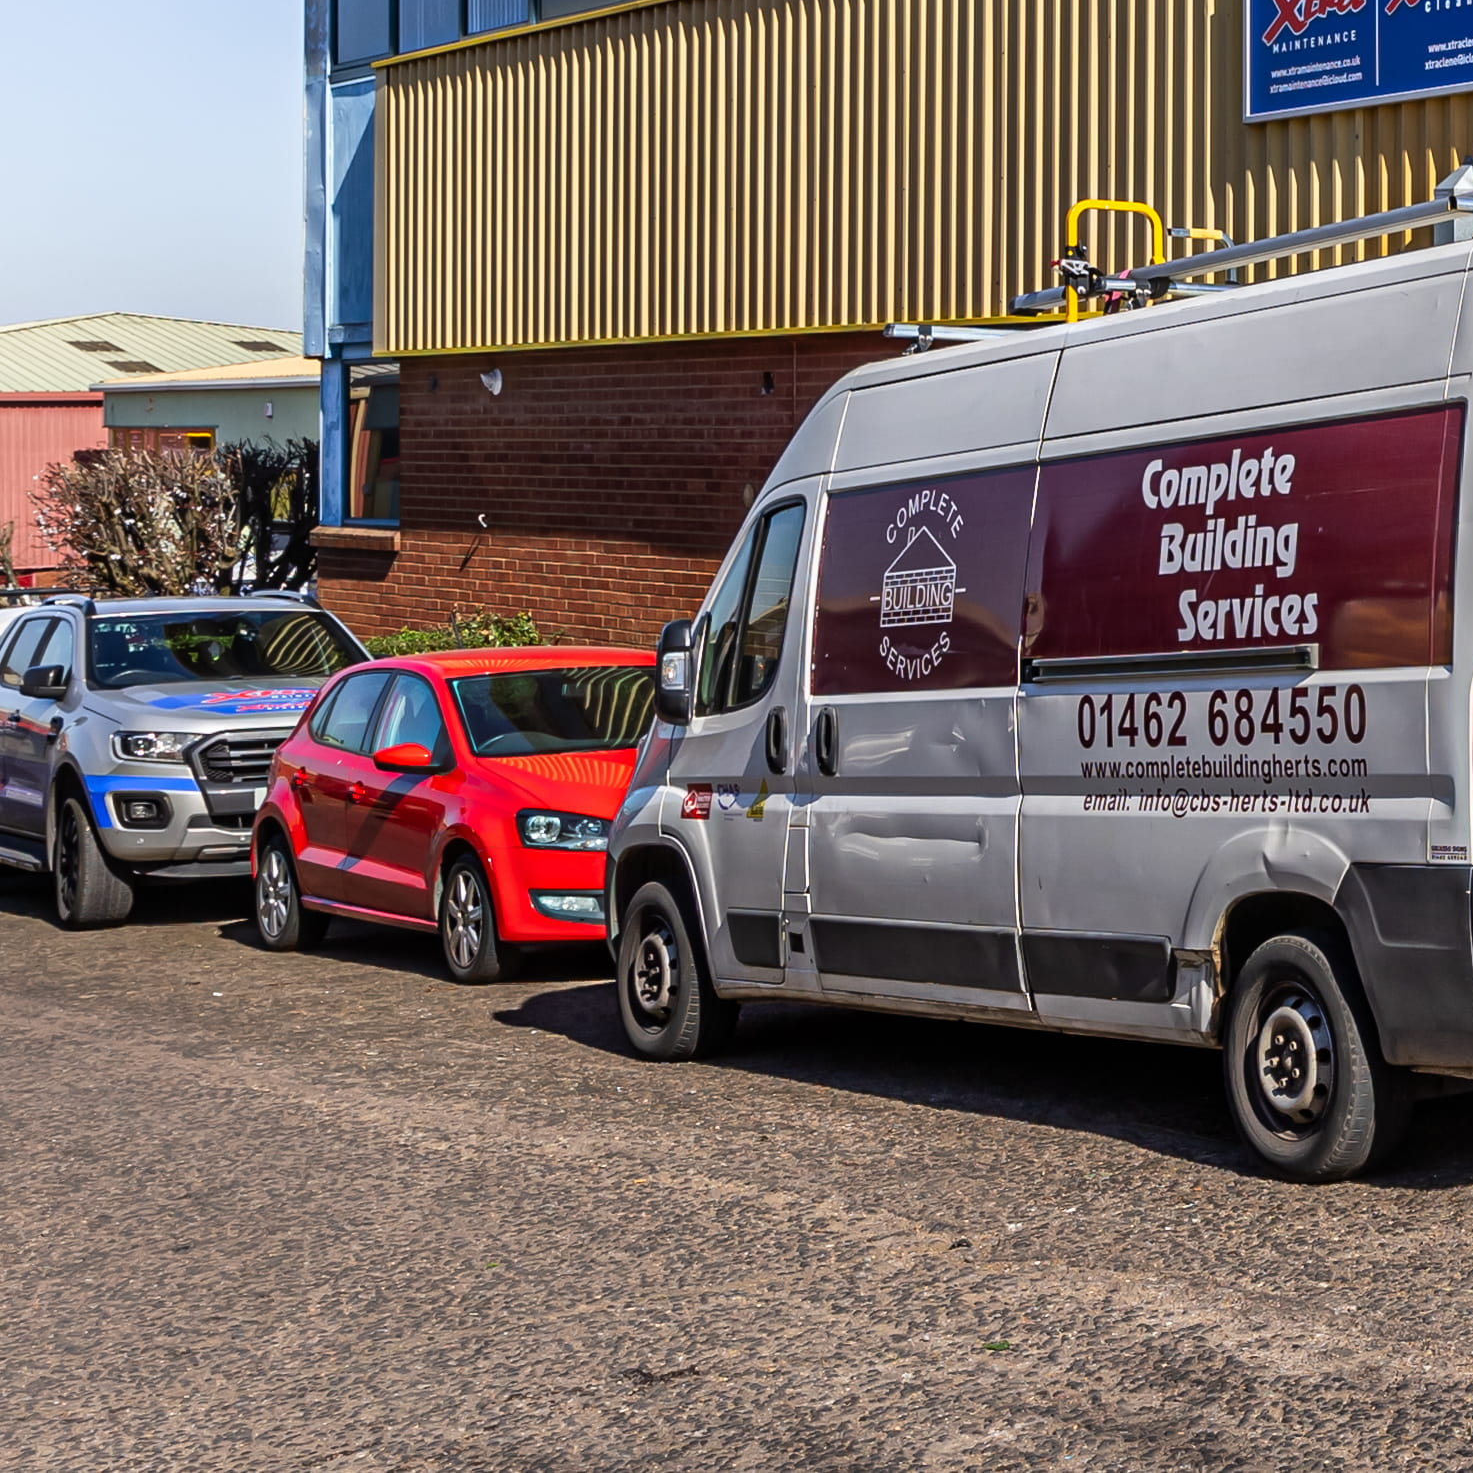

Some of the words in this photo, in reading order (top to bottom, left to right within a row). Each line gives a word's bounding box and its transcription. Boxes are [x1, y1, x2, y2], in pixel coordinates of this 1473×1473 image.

[1272, 30, 1357, 54] MAINTENANCE
[1269, 72, 1363, 94] xtramaintenance@icloud.com
[1271, 54, 1361, 78] www.xtramaintenance.co.uk
[1142, 446, 1296, 515] Complete
[886, 489, 964, 544] COMPLETE
[1158, 515, 1299, 578] Building
[883, 582, 952, 611] BUILDING
[1177, 584, 1319, 642] Services
[879, 631, 950, 680] SERVICES
[1077, 691, 1188, 749] 01462
[1208, 684, 1367, 746] 684550
[1080, 754, 1368, 784] www.completebuildingherts.com
[1083, 790, 1132, 812] email:
[1138, 787, 1371, 818] info@cbs-herts-ltd.co.uk
